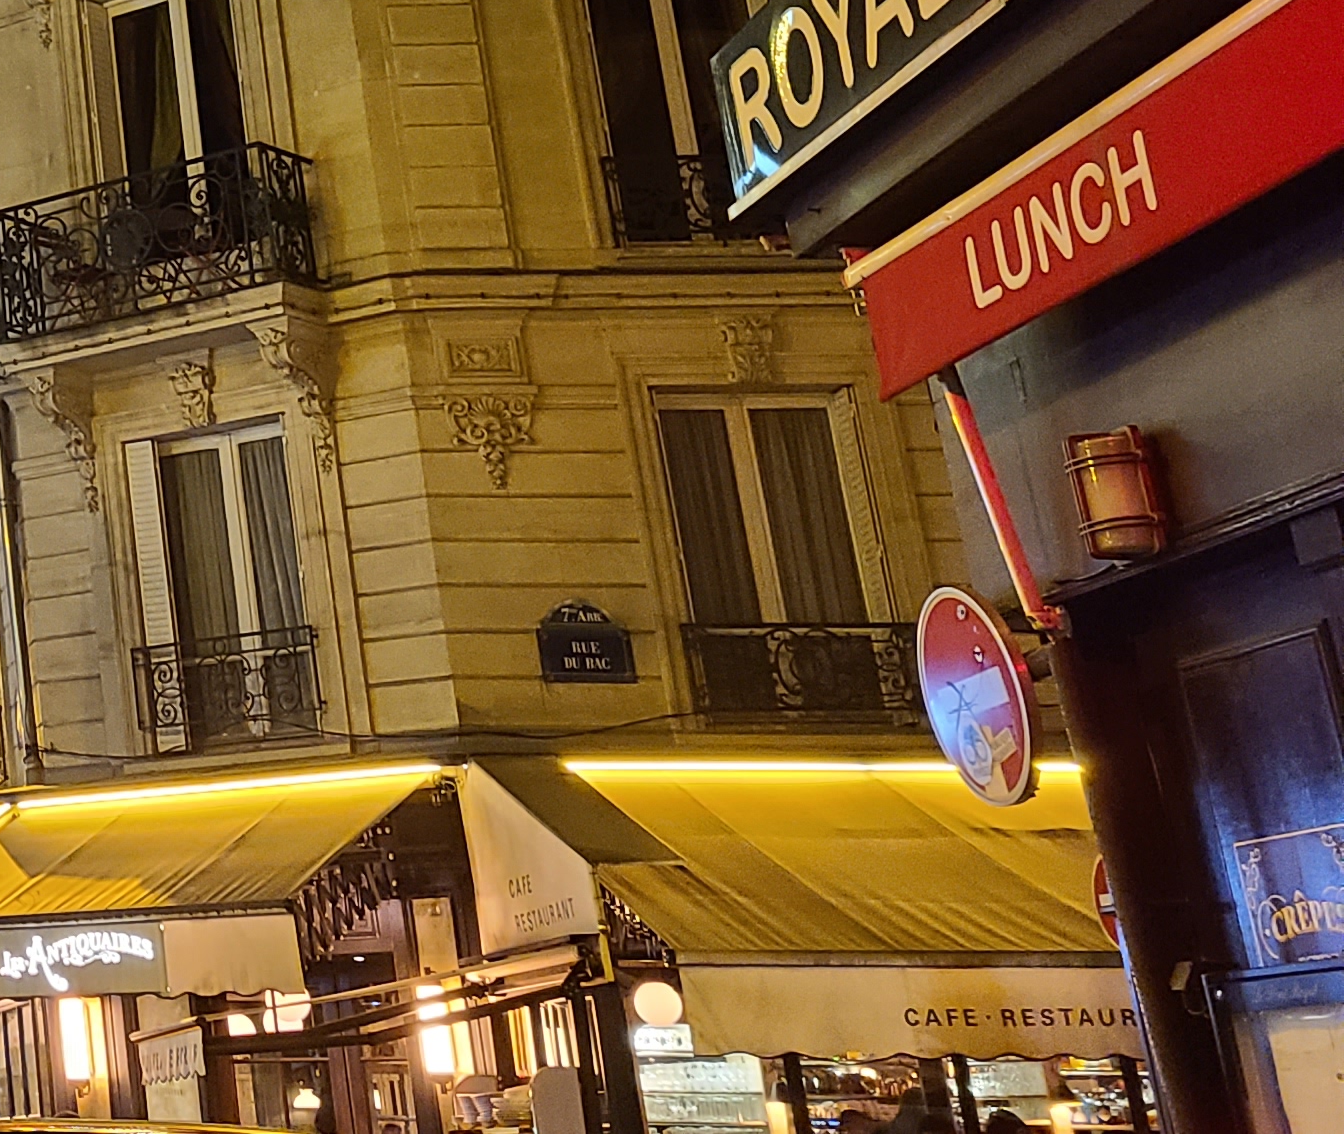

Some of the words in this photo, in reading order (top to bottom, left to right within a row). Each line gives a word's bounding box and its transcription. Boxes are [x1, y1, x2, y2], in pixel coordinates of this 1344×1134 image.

[965, 129, 1158, 309] LUNCH
[571, 641, 601, 654] RUE
[563, 656, 581, 669] DU
[585, 657, 611, 670] BAC
[508, 874, 532, 899] CAFE
[514, 897, 575, 933] RESTAURANT
[904, 1007, 979, 1027] CAFE
